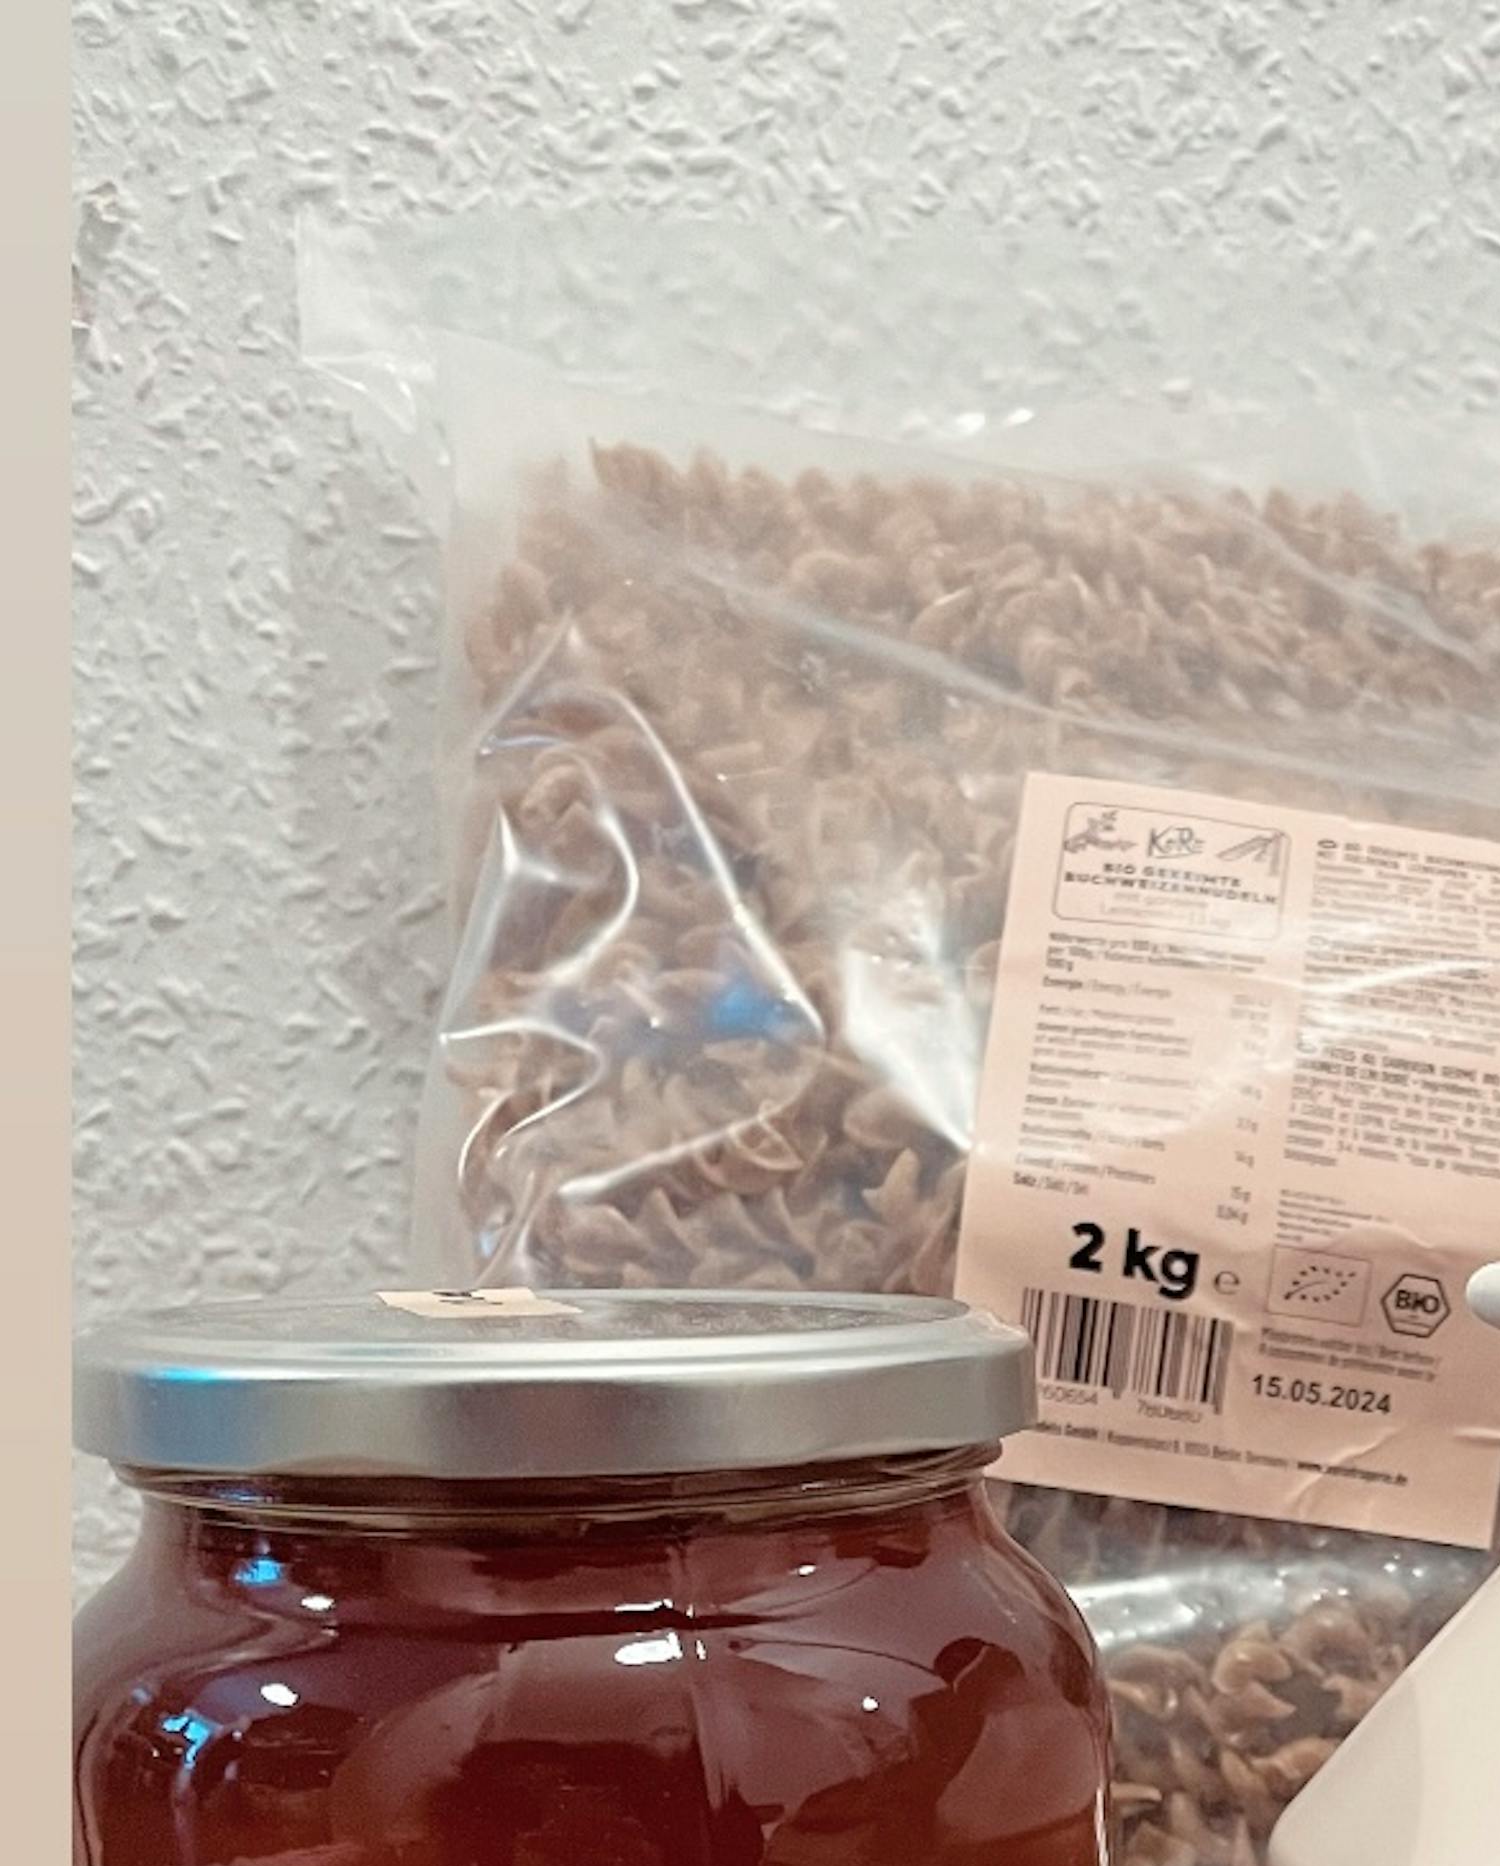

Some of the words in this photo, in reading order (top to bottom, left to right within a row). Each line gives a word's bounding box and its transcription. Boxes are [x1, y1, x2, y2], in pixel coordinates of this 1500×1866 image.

[1069, 1222, 1105, 1274] 2
[1122, 1227, 1200, 1300] kg
[1395, 1289, 1440, 1315] BIO
[1252, 1373, 1392, 1415] 15.05.2024
